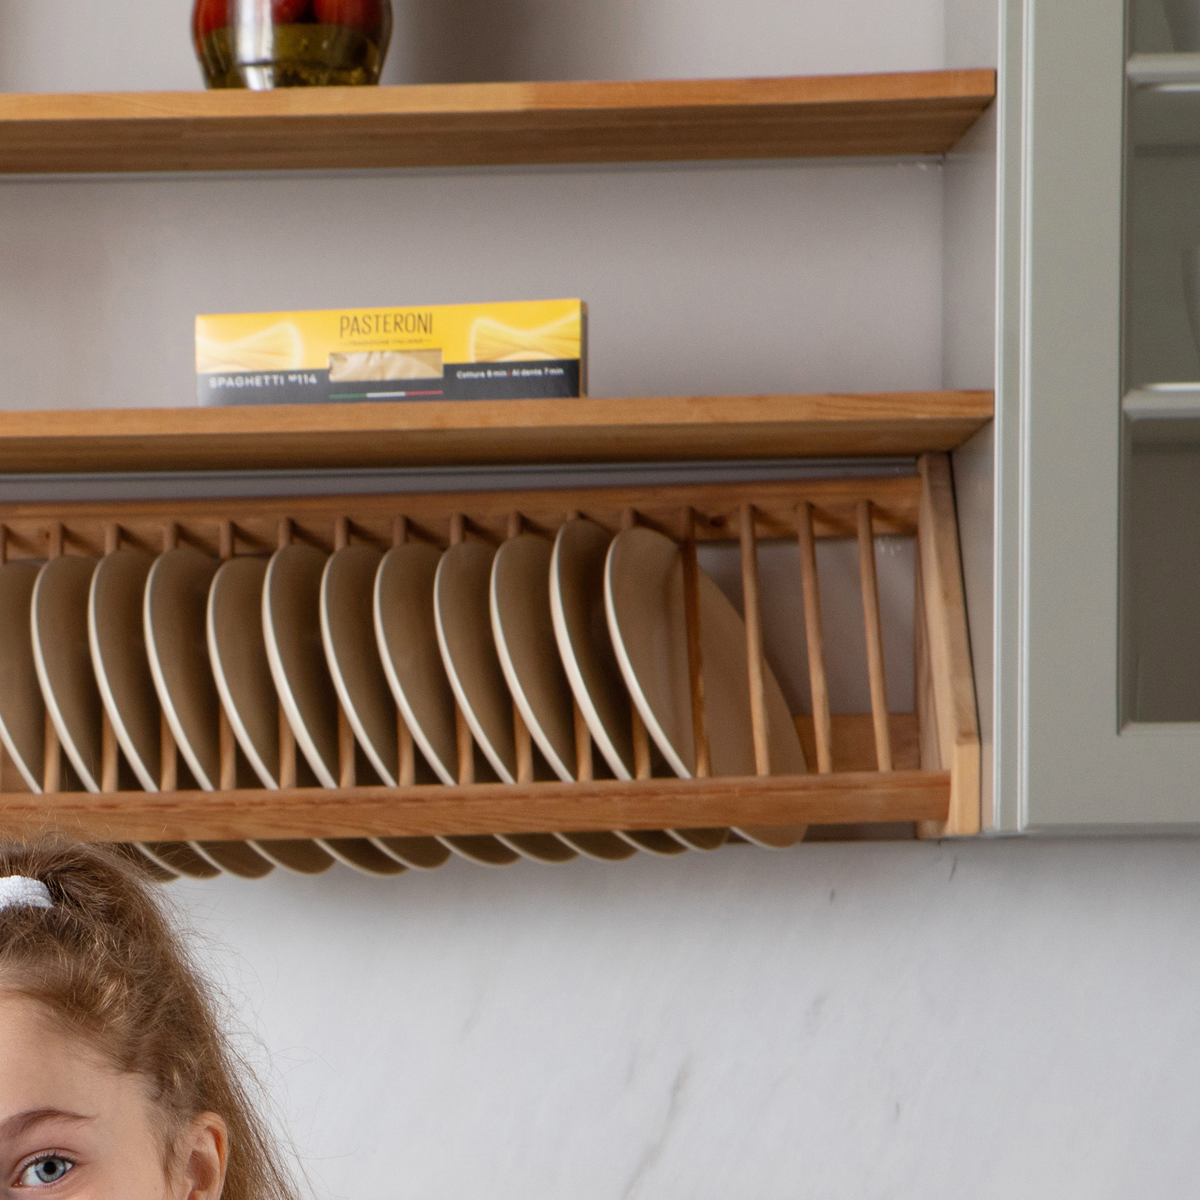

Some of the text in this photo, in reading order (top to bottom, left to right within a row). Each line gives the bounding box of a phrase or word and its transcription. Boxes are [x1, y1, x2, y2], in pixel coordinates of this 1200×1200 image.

[340, 312, 433, 337] PASTERONI
[456, 370, 485, 379] Cottura
[521, 368, 542, 377] dente
[549, 367, 564, 375] min
[208, 374, 285, 389] SPAGHETTI
